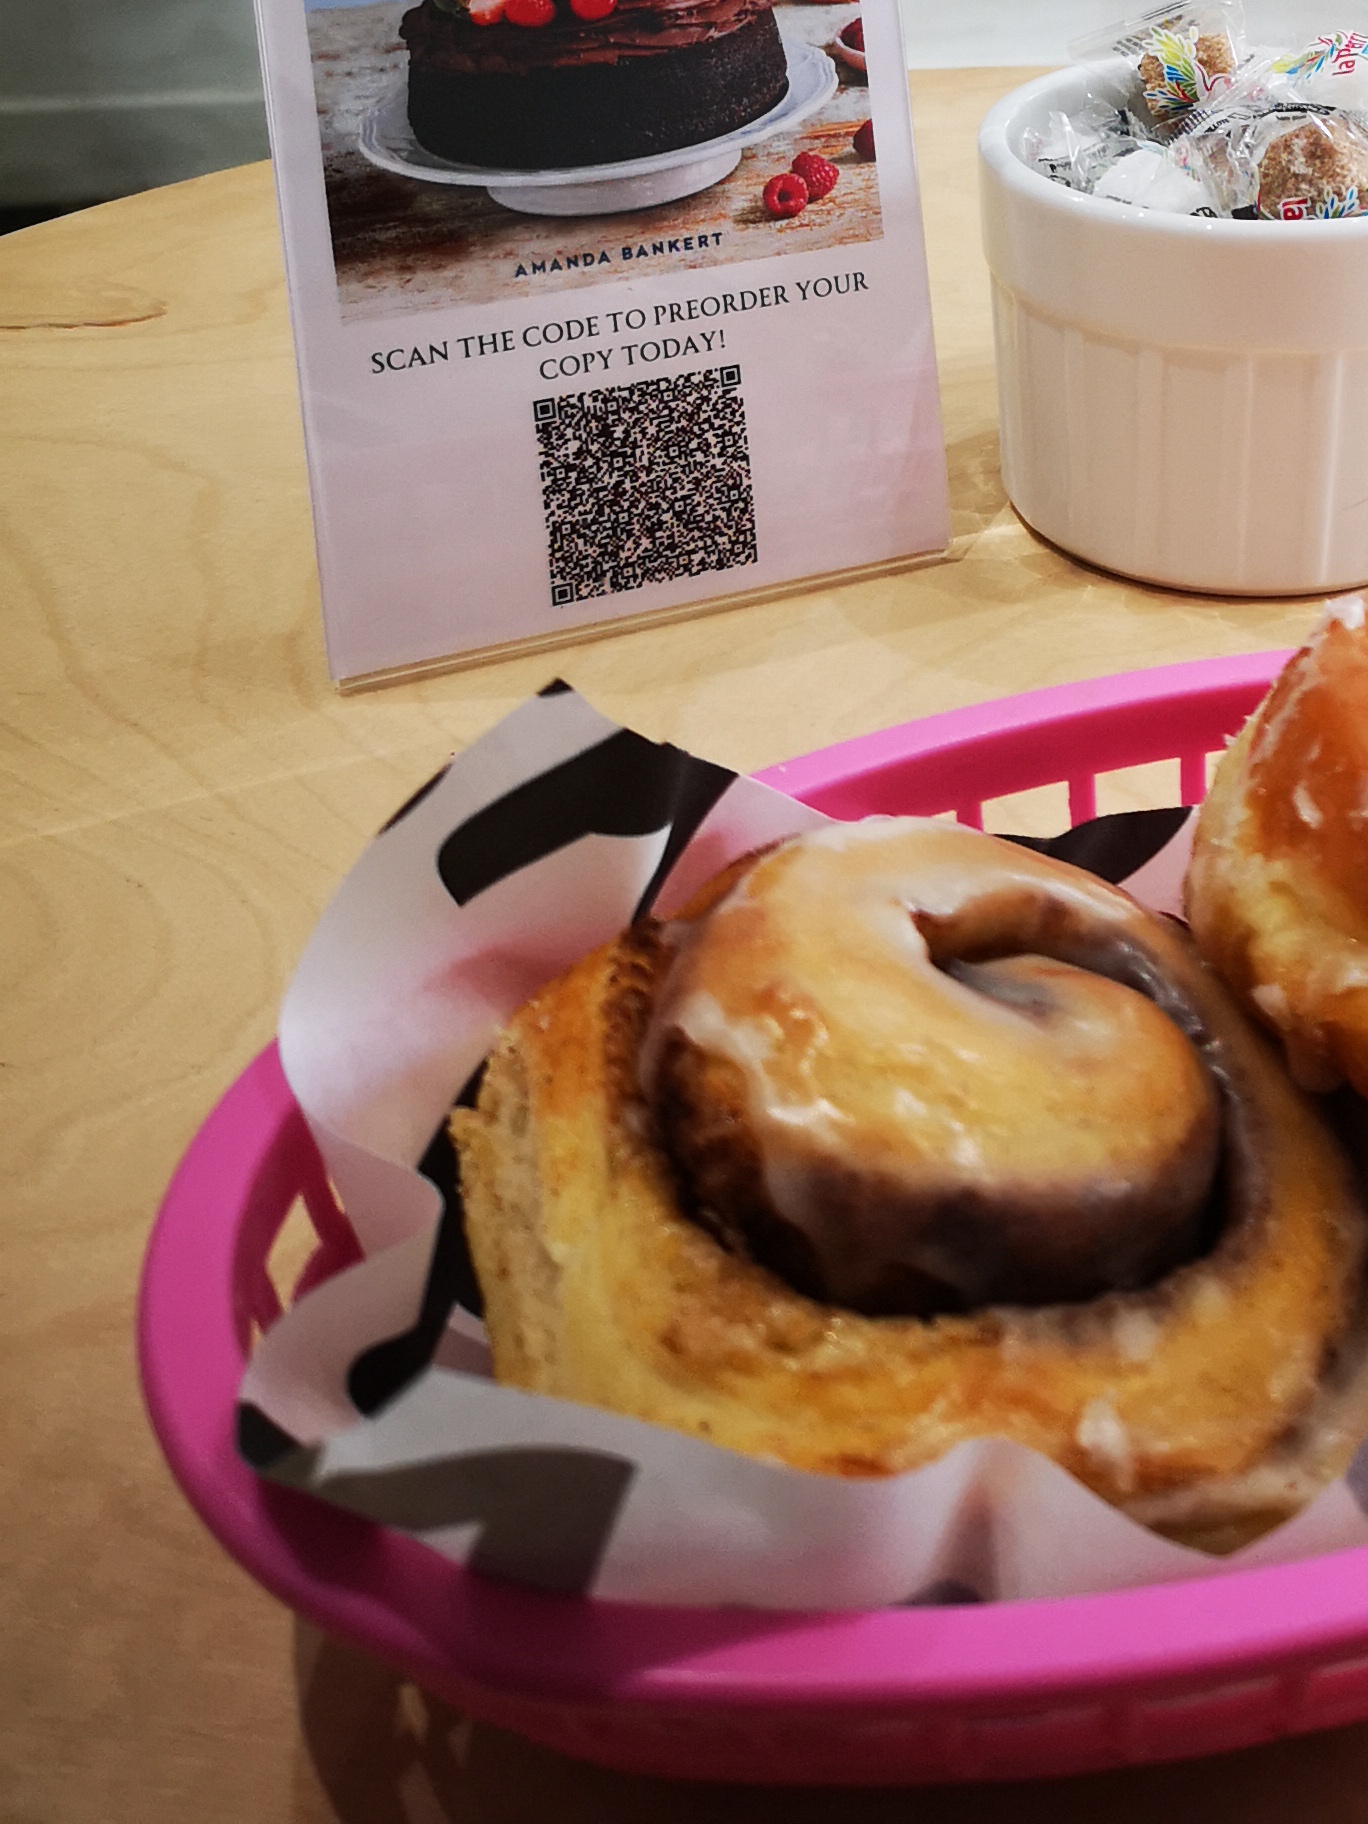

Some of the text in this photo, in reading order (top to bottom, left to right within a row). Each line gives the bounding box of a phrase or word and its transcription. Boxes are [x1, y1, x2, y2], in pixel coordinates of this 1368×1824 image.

[514, 231, 724, 278] AMANDA BANKERT
[371, 271, 869, 374] SCAN THE CODE TO PREORDER YOUR
[539, 326, 726, 380] COPY TODAY!
